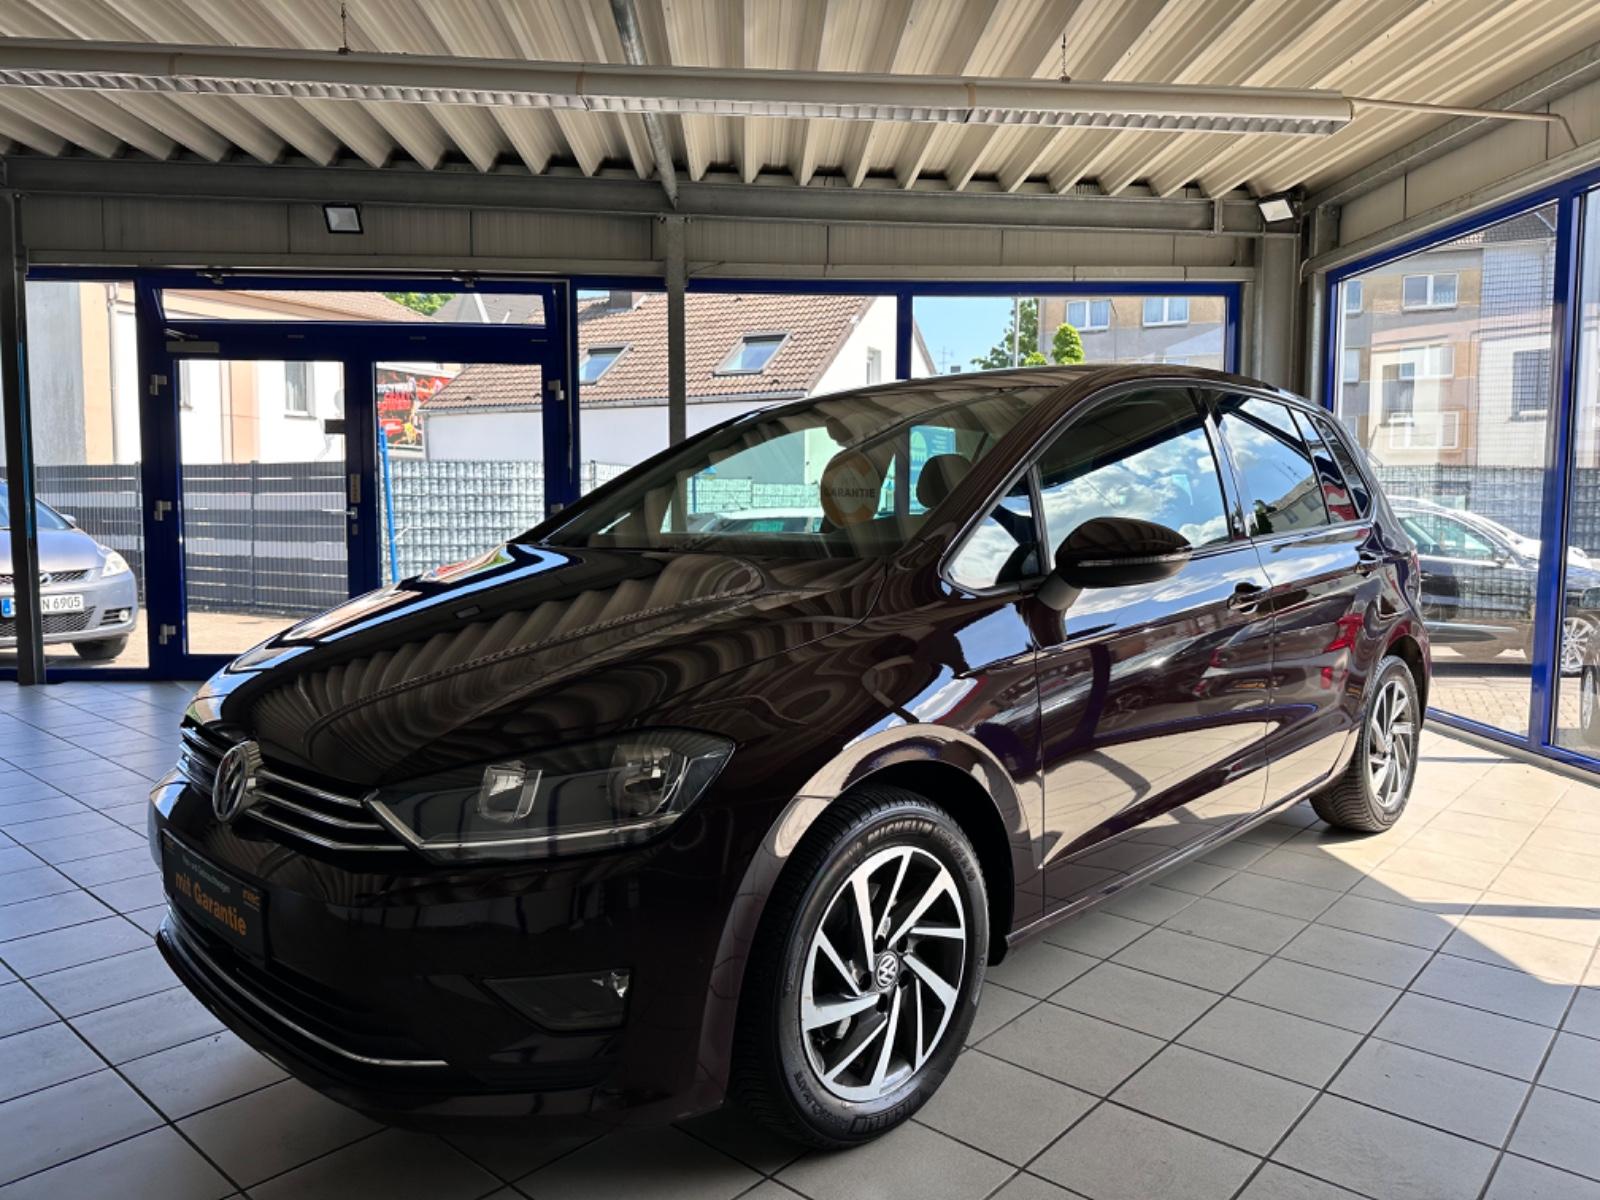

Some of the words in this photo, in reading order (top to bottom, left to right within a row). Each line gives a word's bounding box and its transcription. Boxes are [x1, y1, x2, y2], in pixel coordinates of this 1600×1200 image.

[823, 486, 876, 498] GARANTIE
[53, 596, 81, 609] 6905
[175, 872, 193, 898] mit
[193, 882, 248, 936] Garantie
